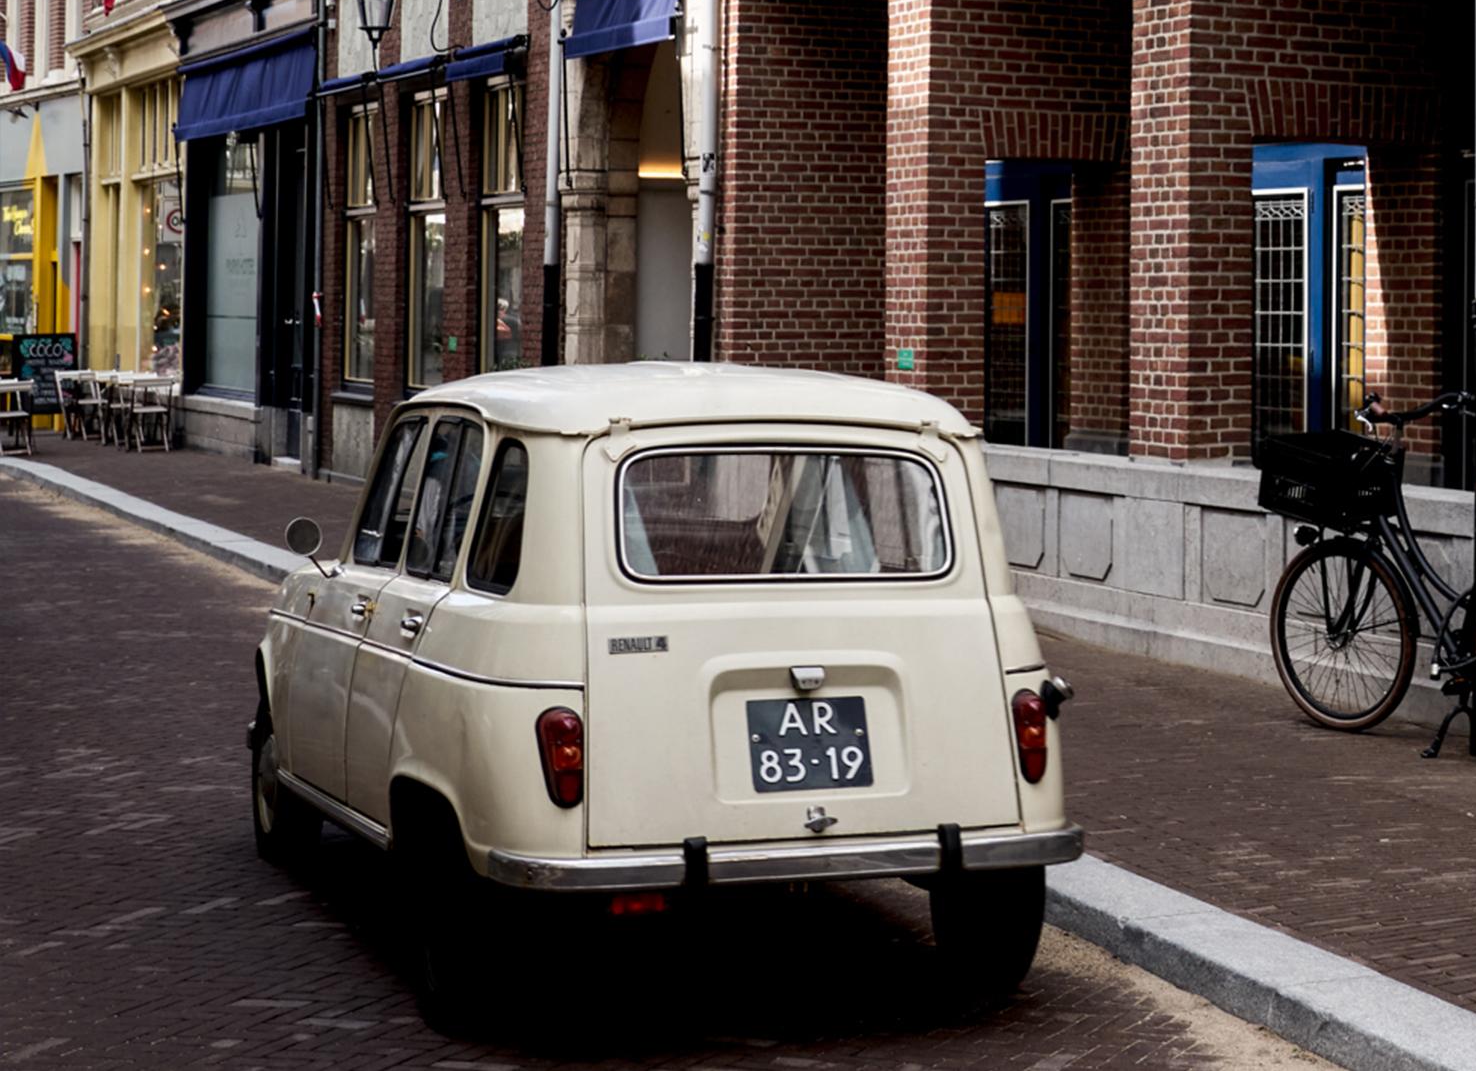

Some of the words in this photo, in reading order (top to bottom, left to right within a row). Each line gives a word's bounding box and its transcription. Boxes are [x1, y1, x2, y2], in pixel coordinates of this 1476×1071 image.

[610, 637, 652, 652] RENAULT
[655, 636, 667, 649] 4
[778, 701, 838, 736] AR
[759, 746, 864, 783] 83-19
